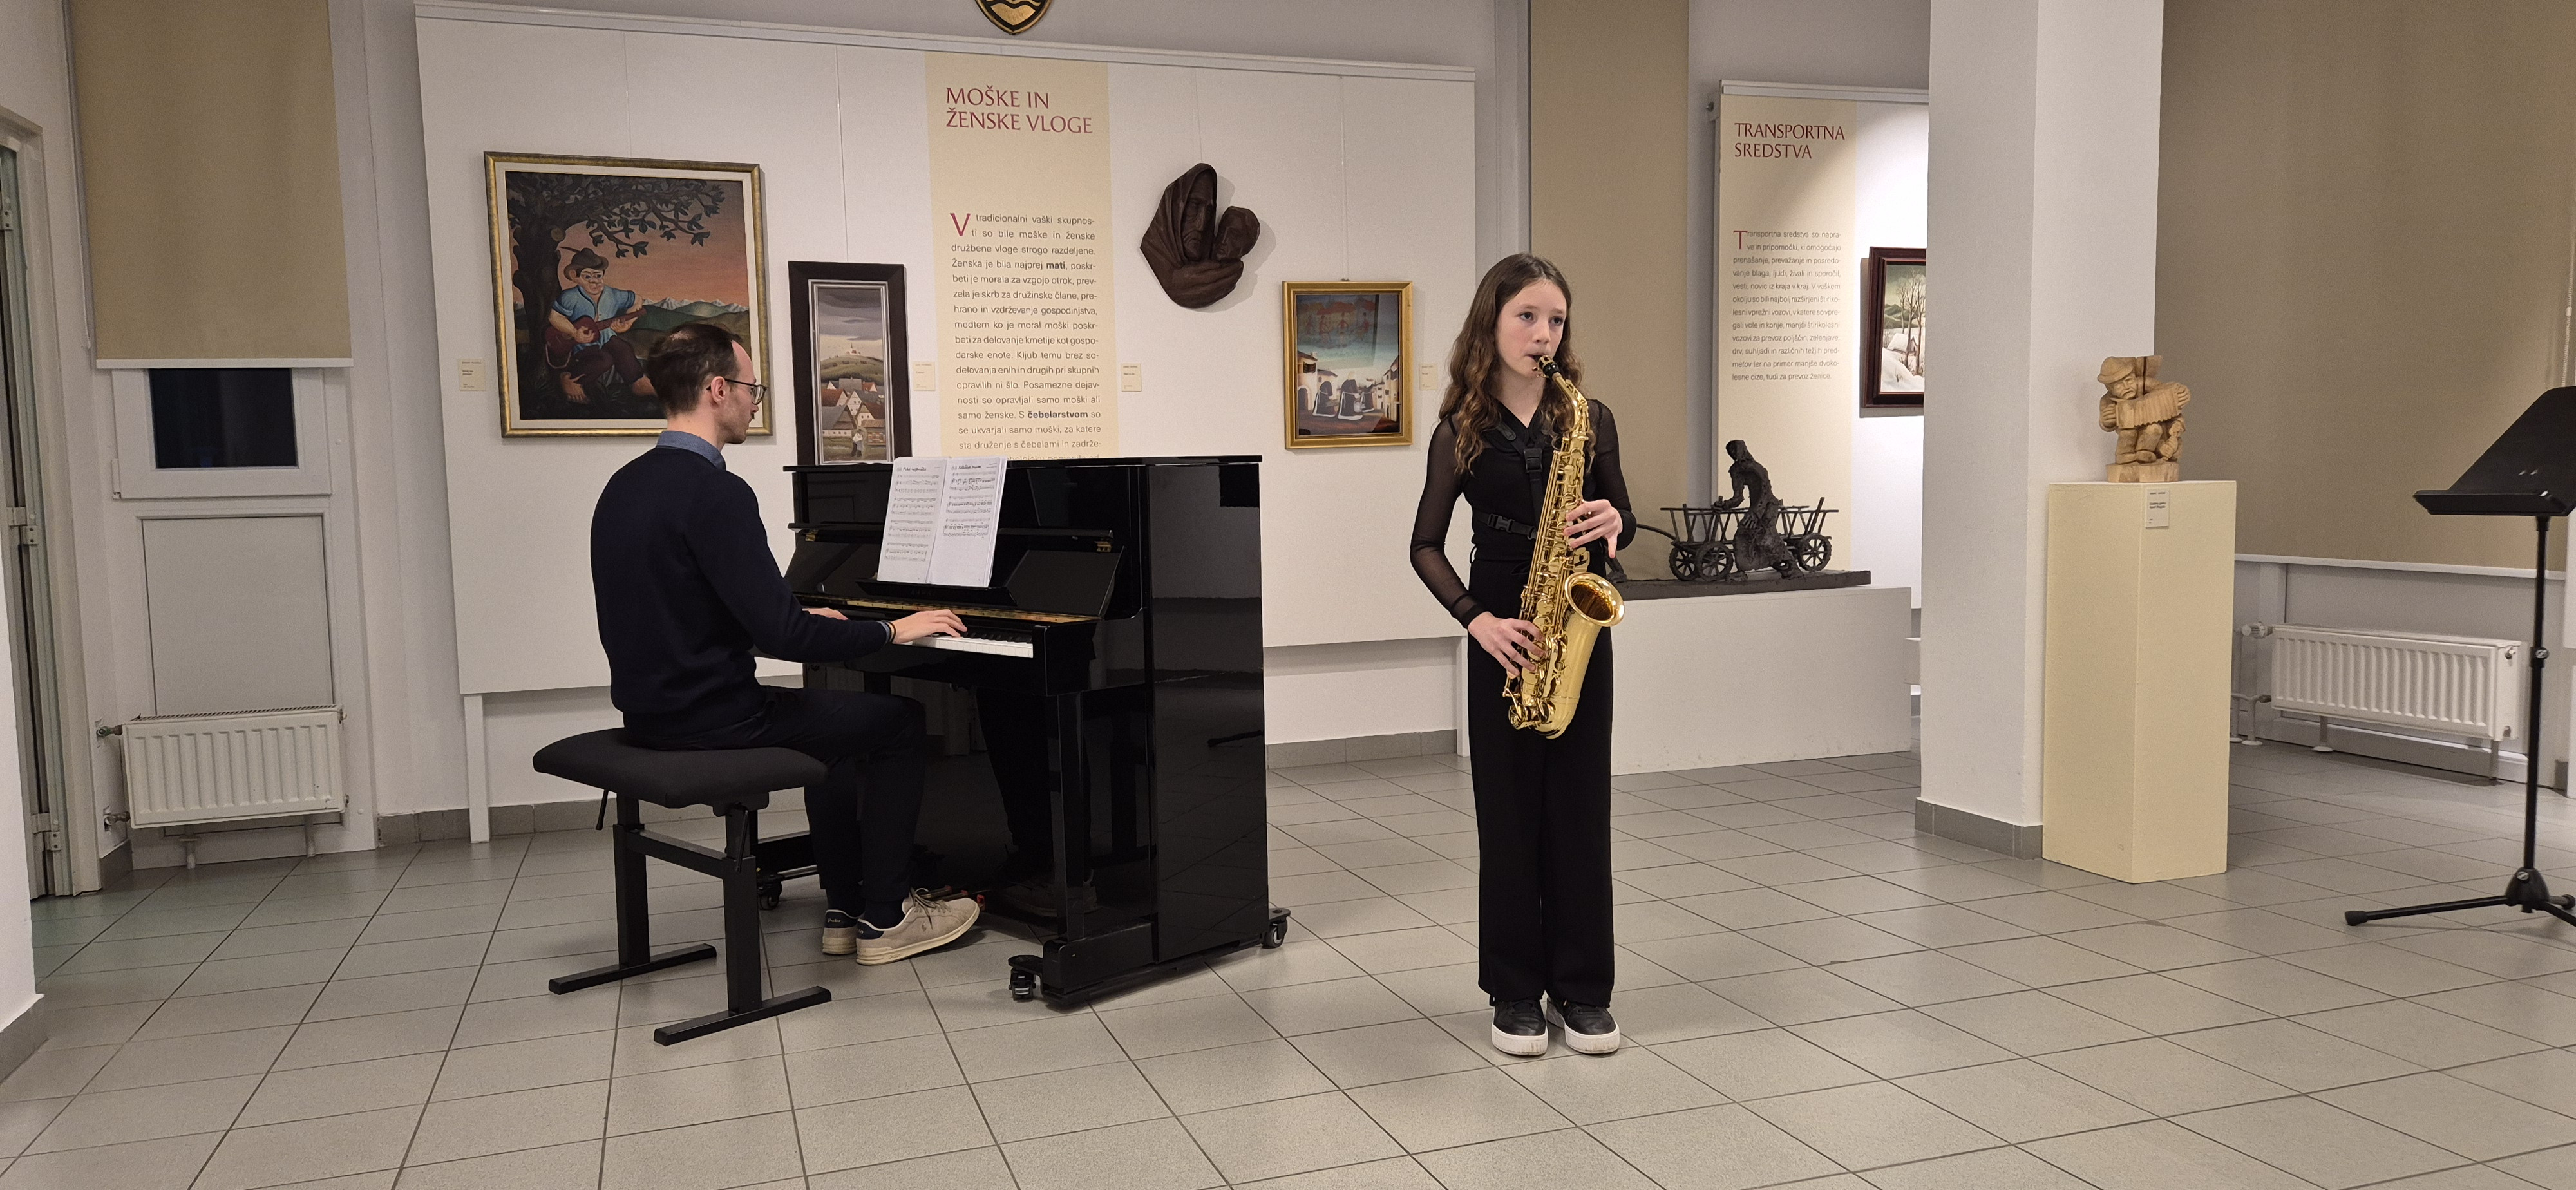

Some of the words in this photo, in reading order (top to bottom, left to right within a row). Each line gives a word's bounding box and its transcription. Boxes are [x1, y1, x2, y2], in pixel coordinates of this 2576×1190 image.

[945, 84, 1021, 108] MOŠKE
[1027, 91, 1050, 109] IN
[945, 107, 1021, 131] ŽENSKE
[1025, 115, 1094, 134] VLOGE
[1734, 122, 1845, 140] TRANSPORTNA
[1734, 142, 1812, 159] SREDSTVA
[950, 212, 971, 237] V
[975, 213, 1028, 223] tradicionalni
[1032, 215, 1053, 224] vaški
[1057, 216, 1095, 226] skupnos-
[971, 228, 977, 237] ti
[998, 229, 1014, 238] bile
[1019, 230, 1048, 239] moške
[1052, 231, 1061, 240] in
[1065, 231, 1095, 240] ženske
[951, 243, 992, 253] družbene
[994, 244, 1018, 255] vloge
[1021, 246, 1048, 256] strogo
[1051, 246, 1096, 257] razdeljene.
[951, 257, 983, 268] Ženska
[985, 259, 994, 270] je
[996, 260, 1012, 269] bila
[1014, 260, 1043, 271] najprej
[1046, 261, 1068, 271] mati,
[1070, 261, 1097, 272] poskr-
[952, 274, 969, 283] beti
[970, 274, 979, 285] je
[980, 275, 1010, 284] morala
[1022, 277, 1050, 286] vzgojo
[1051, 276, 1075, 286] otrok,
[1076, 278, 1097, 287] prev-
[952, 289, 971, 298] zela
[971, 289, 980, 300] je
[981, 290, 1000, 299] skrb
[1012, 290, 1053, 299] družinske
[1054, 290, 1079, 301] člane,
[1081, 292, 1097, 301] pre-
[954, 305, 978, 314] hrano
[980, 305, 989, 314] in
[990, 305, 1038, 316] vzdrževanje
[1041, 306, 1098, 317] gospodinjstva,
[954, 320, 990, 328] medtem
[993, 320, 1003, 329] ko
[1007, 320, 1014, 331] je
[1018, 321, 1041, 329] moral
[1045, 321, 1069, 330] moški
[1072, 321, 1099, 332] poskr-
[954, 335, 971, 344] beti
[983, 335, 1024, 346] delovanje
[1025, 335, 1056, 346] kmetije
[1056, 335, 1069, 345] kot
[1070, 337, 1099, 346] gospo-
[955, 350, 984, 359] darske
[987, 351, 1014, 359] enote.
[1016, 350, 1038, 361] Kljub
[1065, 351, 1083, 359] brez
[956, 365, 997, 376] delovanja
[998, 366, 1016, 374] enih
[1018, 366, 1026, 375] in
[1027, 366, 1054, 376] drugih
[1055, 366, 1066, 375] pri
[1067, 366, 1099, 375] skupnih
[956, 381, 992, 391] opravilih
[995, 381, 1003, 389] ni
[1006, 381, 1020, 390] šlo.
[1023, 381, 1072, 389] Posamezne
[1075, 381, 1100, 391] dejav-
[996, 395, 1034, 406] opravljali
[1063, 395, 1088, 404] moški
[1090, 395, 1101, 404] ali
[984, 410, 1016, 419] ženske.
[1018, 410, 1025, 419] S
[1027, 410, 1088, 419] čebelarstvom
[971, 426, 1007, 436] ukvarjali
[1035, 425, 1062, 434] moški,
[1075, 424, 1101, 433] katere
[974, 440, 1012, 451] druženje
[1021, 440, 1059, 449] čebelami
[1061, 440, 1069, 448] in
[1071, 439, 1102, 448] zadrže-
